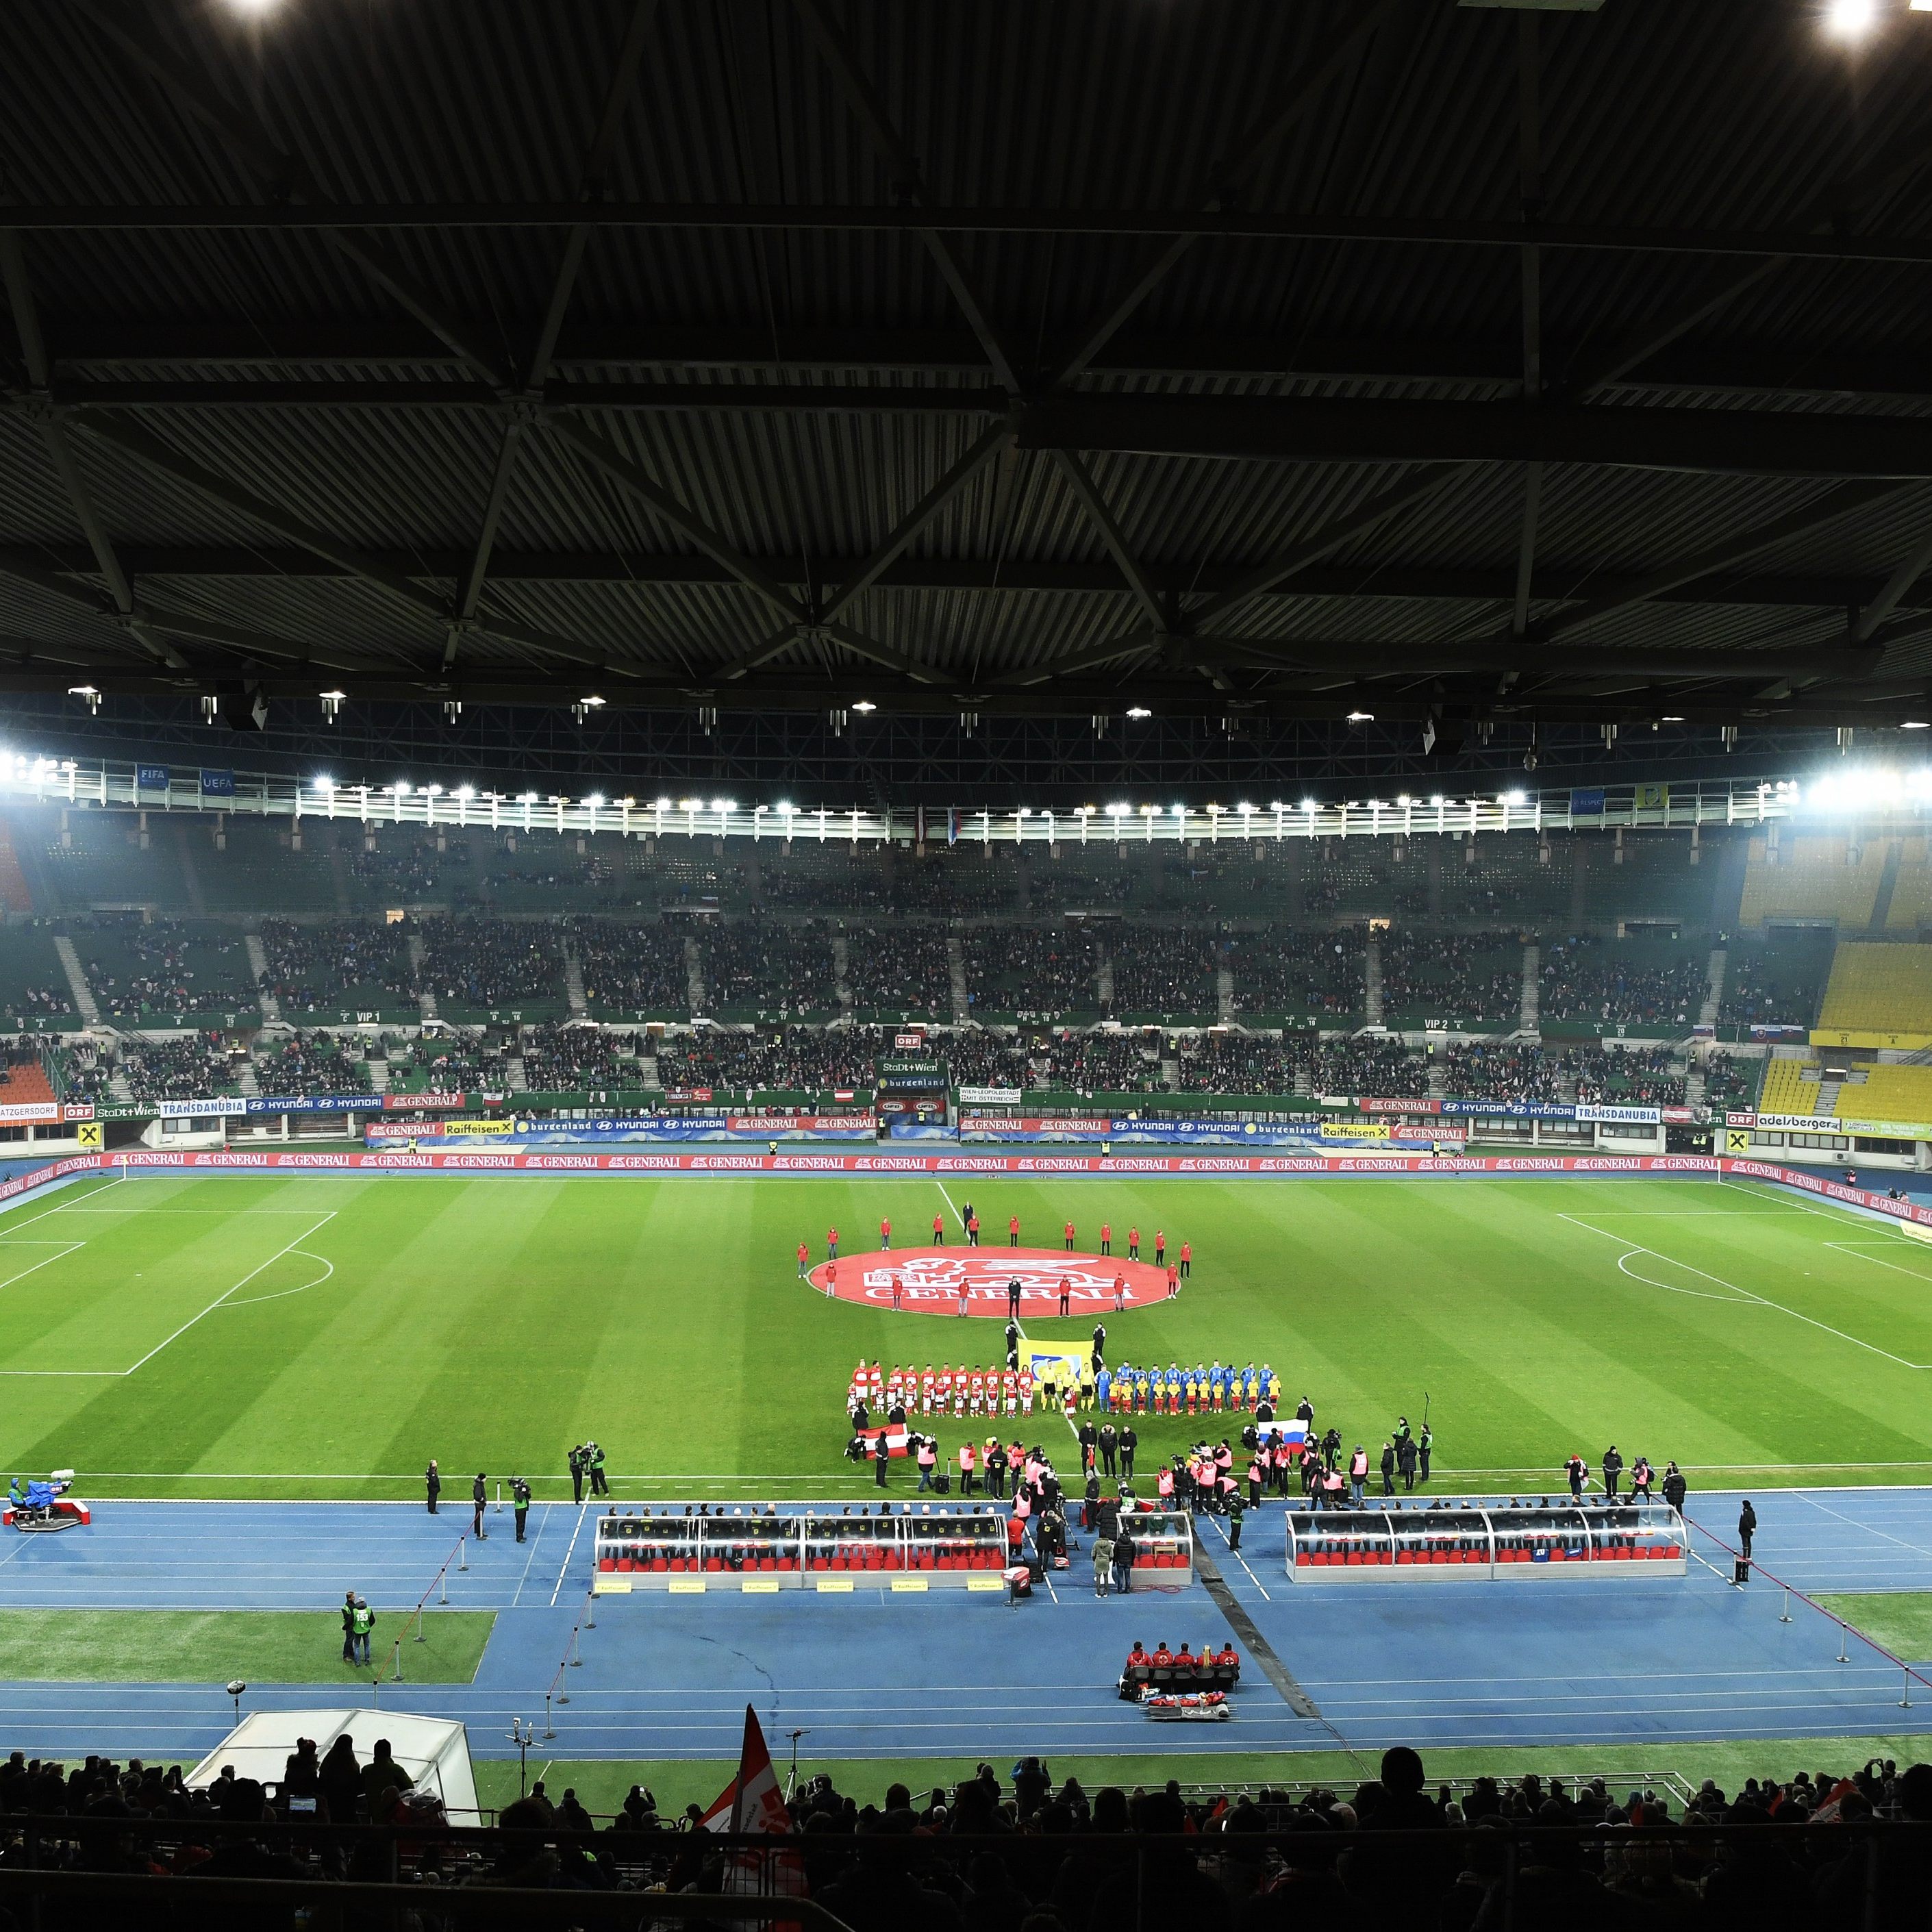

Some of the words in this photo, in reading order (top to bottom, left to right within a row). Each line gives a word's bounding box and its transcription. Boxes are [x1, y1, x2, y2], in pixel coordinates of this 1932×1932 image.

[141, 770, 164, 779] FIFA
[203, 779, 231, 788] UEFA
[357, 1012, 373, 1022] VIP
[375, 1012, 379, 1022] 1
[1425, 1019, 1440, 1029] VIP
[1442, 1019, 1448, 1029] 2
[890, 1078, 944, 1087] burgenland
[268, 1100, 313, 1108] HYUNDAI
[338, 1099, 381, 1107] HYUNDAI
[1383, 1101, 1431, 1112] GENERALI
[0, 1107, 55, 1117] ATZGERSDORF
[68, 1109, 92, 1117] ORF
[164, 1103, 243, 1114] TRANSDANUBIA
[1462, 1105, 1506, 1113] HYUNDAI
[1530, 1107, 1574, 1115] HYUNDAI
[1579, 1108, 1657, 1120] TRANSDANUBIA
[616, 1120, 659, 1128] HYUNDAI
[683, 1120, 725, 1128] HYUNDAI
[751, 1119, 797, 1128] GENERALI
[829, 1118, 876, 1127] GENERALI
[975, 1120, 1022, 1130] GENERALI
[1055, 1121, 1101, 1130] GENERALI
[1729, 1116, 1753, 1125] ORF
[386, 1125, 436, 1135] GENERALI
[447, 1125, 499, 1134] Raiffeisen
[531, 1121, 591, 1131] burgenland
[1131, 1122, 1175, 1131] HYUNDAI
[1198, 1124, 1240, 1132] HYUNDAI
[1259, 1125, 1318, 1134] burgenland
[1323, 1128, 1375, 1137] Raiffeisen
[1414, 1129, 1462, 1139] GENERALI
[62, 1156, 101, 1172] GENERALI
[129, 1154, 184, 1164] GENERALI
[213, 1155, 268, 1164] GENERALI
[295, 1155, 349, 1165] GENERALI
[378, 1155, 433, 1166] GENERALI
[460, 1156, 515, 1166] GENERALI
[544, 1157, 598, 1167] GENERALI
[626, 1157, 680, 1167] GENERALI
[709, 1157, 762, 1168] GENERALI
[790, 1157, 844, 1168] GENERALI
[873, 1158, 926, 1168] GENERALI
[954, 1158, 1007, 1168] GENERALI
[1036, 1159, 1089, 1169] GENERALI
[1116, 1159, 1169, 1169] GENERALI
[1196, 1159, 1249, 1169] GENERALI
[1276, 1159, 1329, 1169] GENERALI
[1356, 1159, 1408, 1169] GENERALI
[1434, 1159, 1485, 1169] GENERALI
[1513, 1159, 1564, 1168] GENERALI
[1590, 1158, 1641, 1168] GENERALI
[33, 1166, 53, 1184] GENERALI
[1746, 1163, 1782, 1180] GENERALI
[2, 1178, 24, 1197] GENERALI
[1794, 1175, 1822, 1192] GENERALI
[1835, 1185, 1865, 1204] GENERALI
[1880, 1199, 1911, 1218] GENERALI
[865, 1288, 1140, 1300] GENERALI
